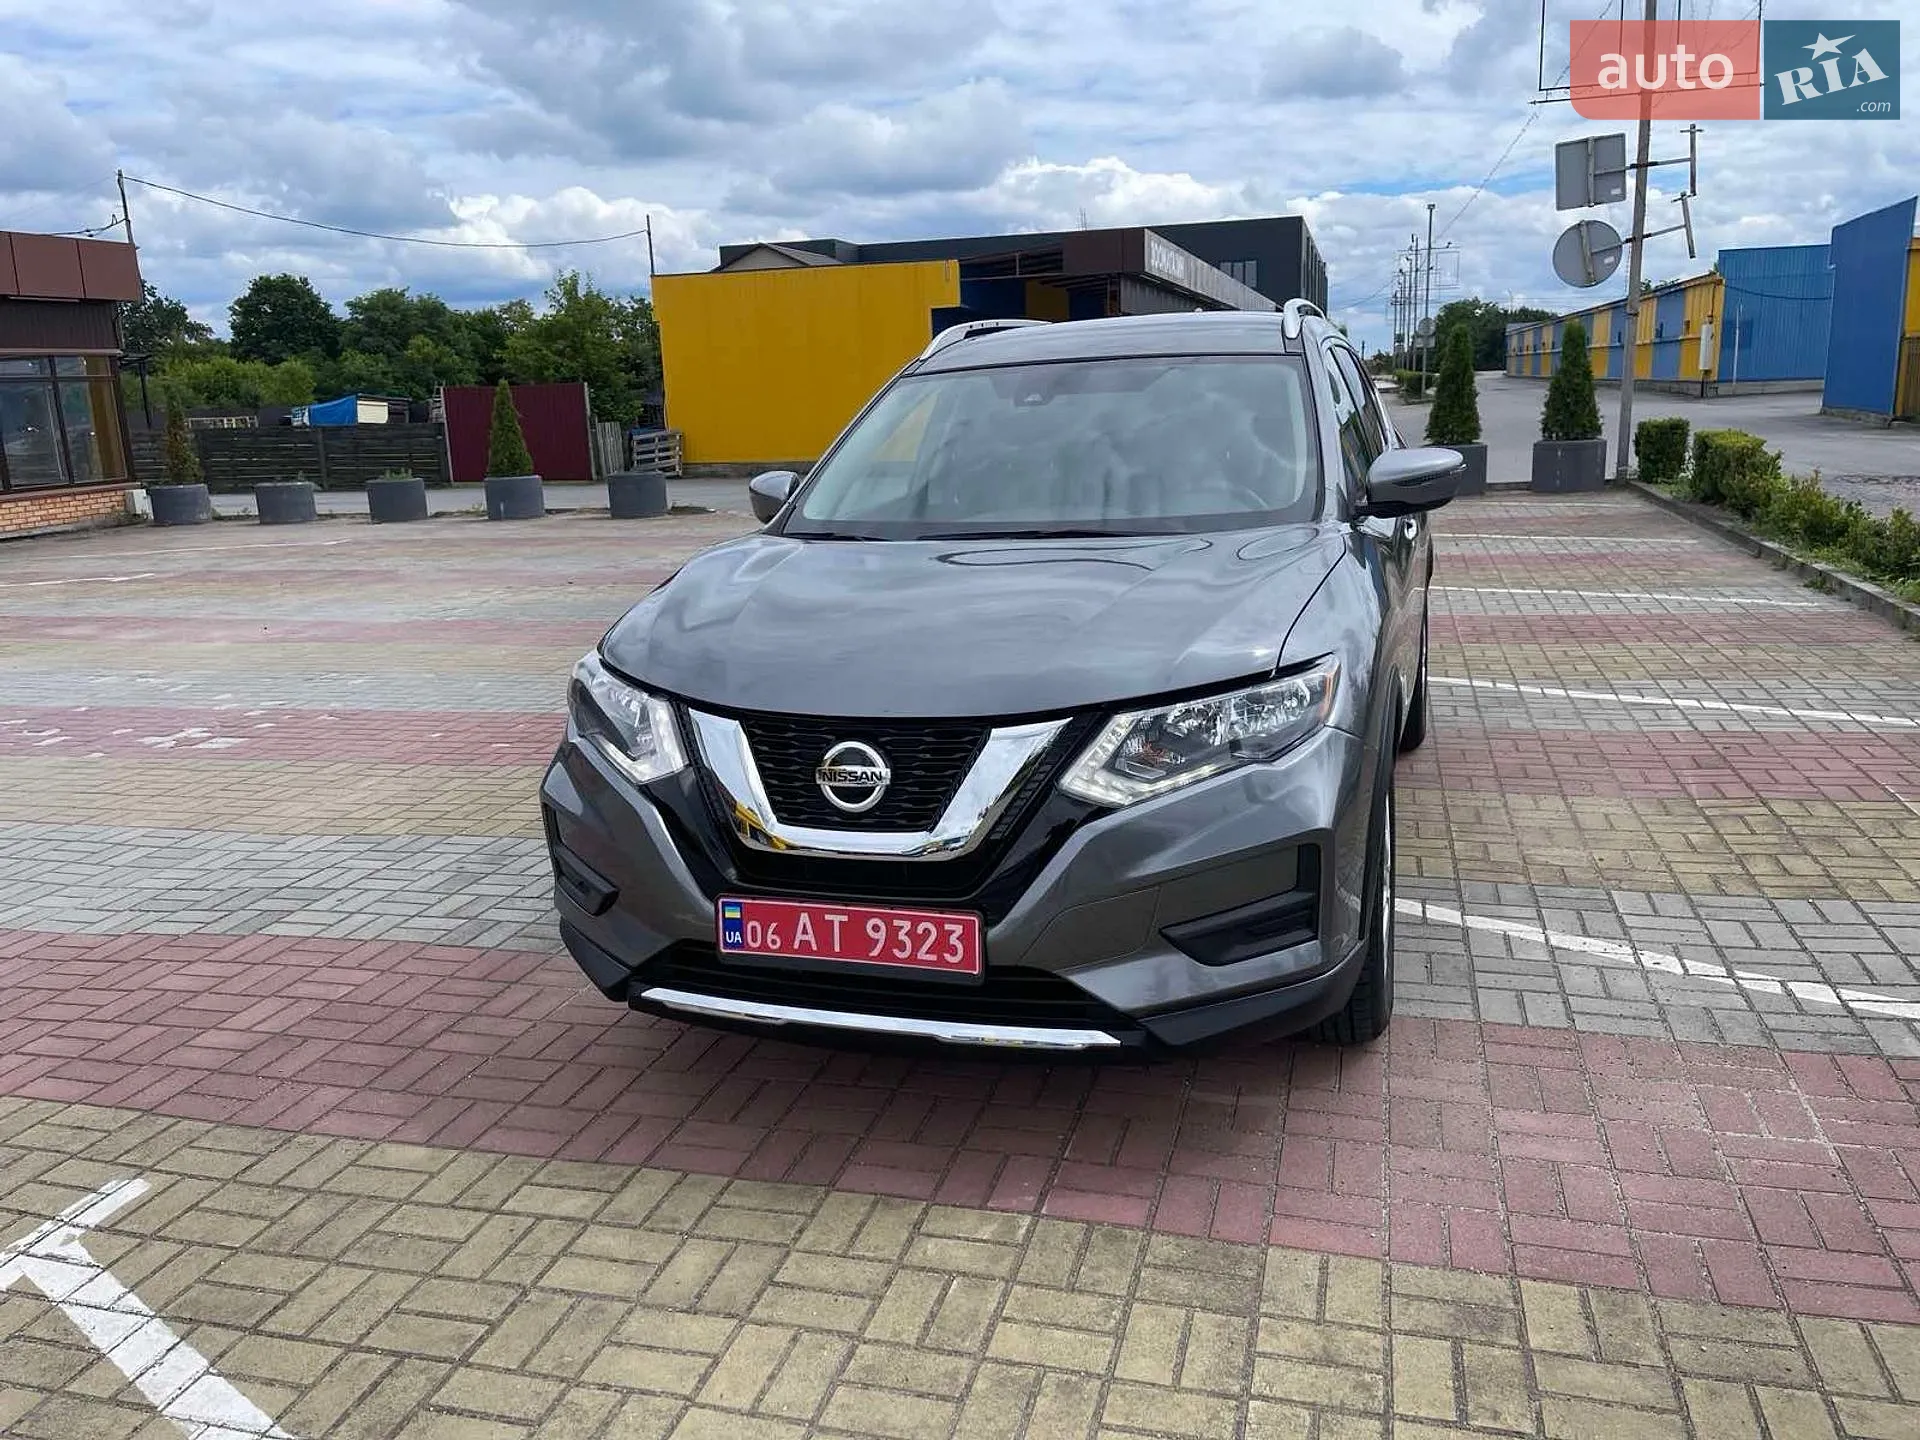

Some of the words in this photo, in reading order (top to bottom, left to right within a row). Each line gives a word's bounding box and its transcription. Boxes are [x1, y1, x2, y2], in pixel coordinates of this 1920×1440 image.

[822, 770, 882, 782] NISSAN
[725, 930, 742, 944] UA
[746, 920, 782, 950] 06
[793, 912, 848, 953] AT
[865, 917, 964, 964] 9323
